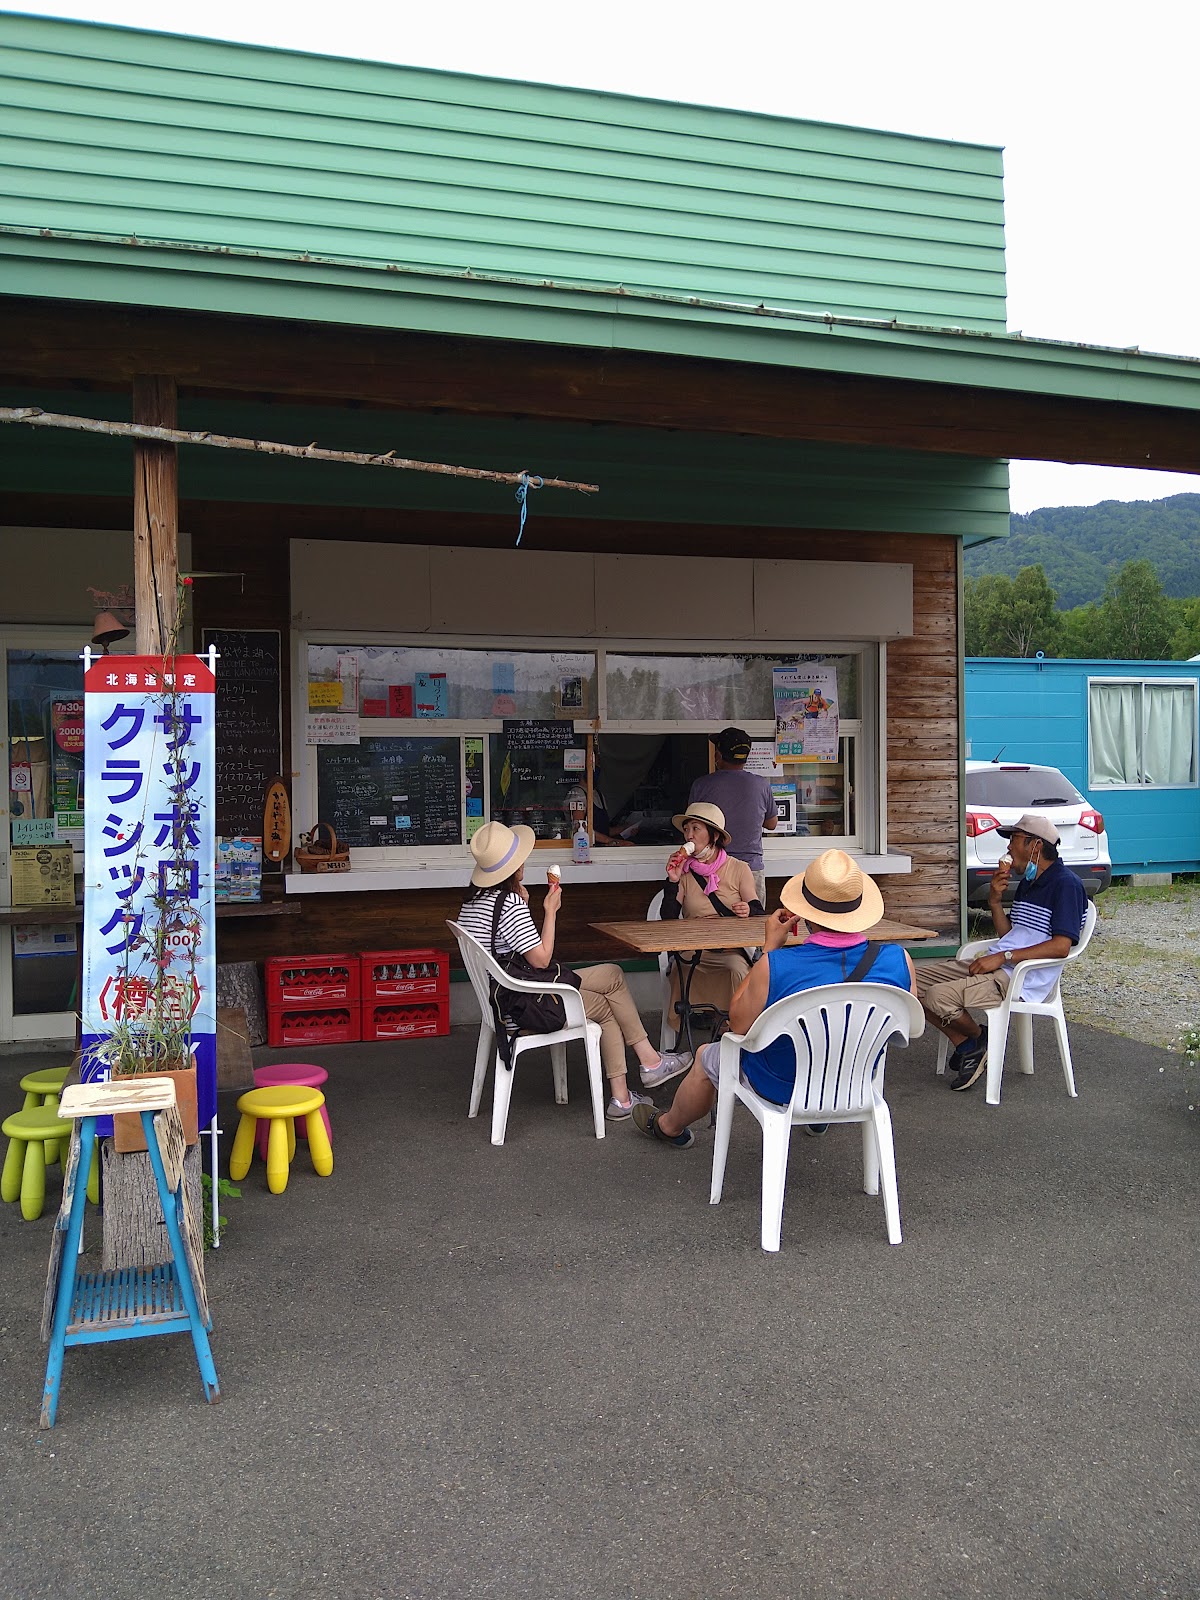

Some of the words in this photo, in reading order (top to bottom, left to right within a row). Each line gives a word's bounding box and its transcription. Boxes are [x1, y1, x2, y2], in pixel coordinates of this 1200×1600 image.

[214, 632, 247, 644] ようこそ
[216, 660, 246, 668] ELCOME
[105, 672, 197, 687] 北海道限定
[222, 696, 247, 705] バニラ
[421, 753, 448, 764] 飲み物
[215, 759, 264, 772] アイスコーヒー
[215, 771, 269, 783] アイスカフェオレ
[153, 702, 202, 899] サッポロ
[333, 809, 364, 818] かき氷
[99, 702, 145, 957] クラシック
